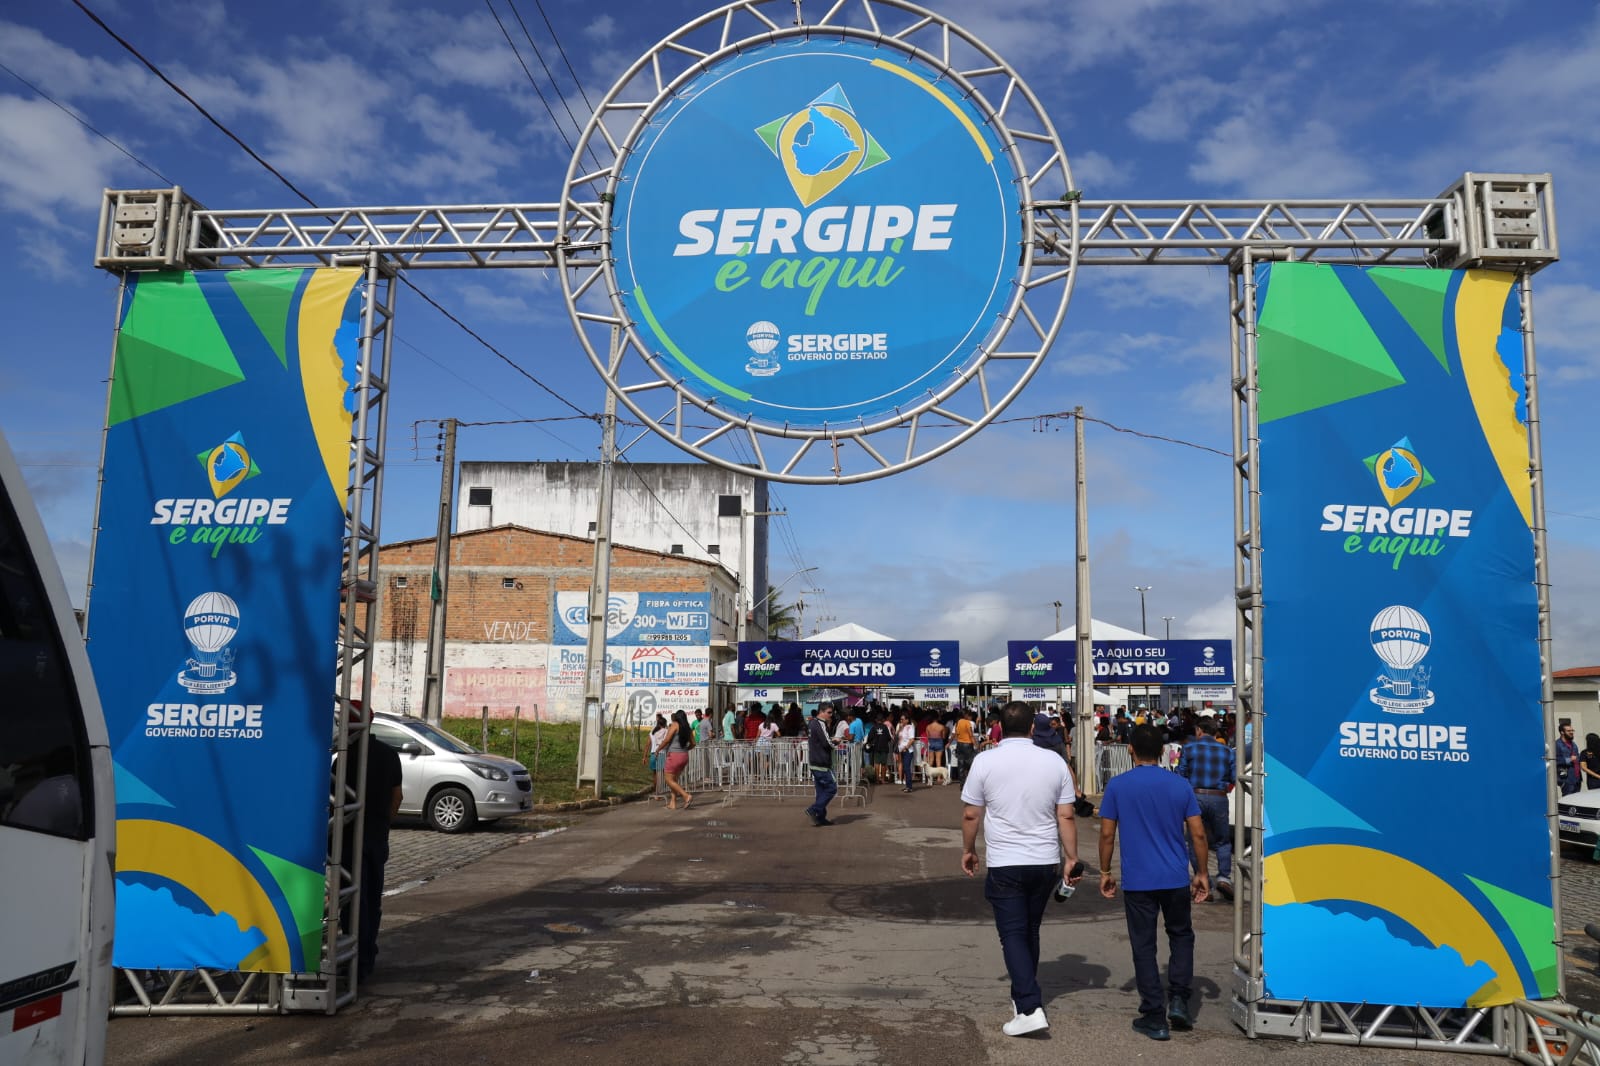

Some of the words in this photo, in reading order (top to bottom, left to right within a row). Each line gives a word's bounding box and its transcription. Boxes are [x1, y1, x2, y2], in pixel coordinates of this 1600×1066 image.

[673, 204, 958, 256] SERGIPE
[714, 242, 751, 292] é
[761, 237, 905, 316] aqui
[787, 333, 888, 352] SERGIPE
[787, 352, 833, 361] GOVERNO
[834, 352, 848, 360] DO
[850, 351, 888, 360] ESTADO
[150, 498, 292, 525] SERGIPE
[1320, 504, 1473, 537] SERGIPE
[169, 518, 188, 545] é
[191, 517, 263, 558] aqui
[1343, 525, 1364, 553] é
[1368, 528, 1445, 570] aqui
[194, 615, 230, 625] PORVIR
[634, 615, 656, 628] 300
[1380, 629, 1421, 641] PORVIR
[804, 649, 832, 660] FAÇA
[835, 649, 859, 659] AQUI
[861, 649, 870, 659] O
[871, 649, 892, 659] SEU
[1106, 648, 1132, 658] AQUI
[1135, 648, 1143, 657] O
[1145, 648, 1166, 657] SEU
[631, 661, 675, 679] HMC
[743, 663, 781, 671] SERGIPE
[801, 662, 896, 677] CADASTRO
[1015, 663, 1053, 671] SERGIPE
[754, 689, 768, 697] RG
[146, 703, 263, 727] SERGIPE
[145, 727, 197, 738] GOVERNO
[200, 728, 216, 738] DO
[218, 728, 263, 739] ESTADO
[1339, 721, 1468, 750] SERGIPE
[1339, 747, 1398, 760] GOVERNO
[1401, 749, 1418, 760] DO
[1420, 750, 1470, 762] ESTADO
